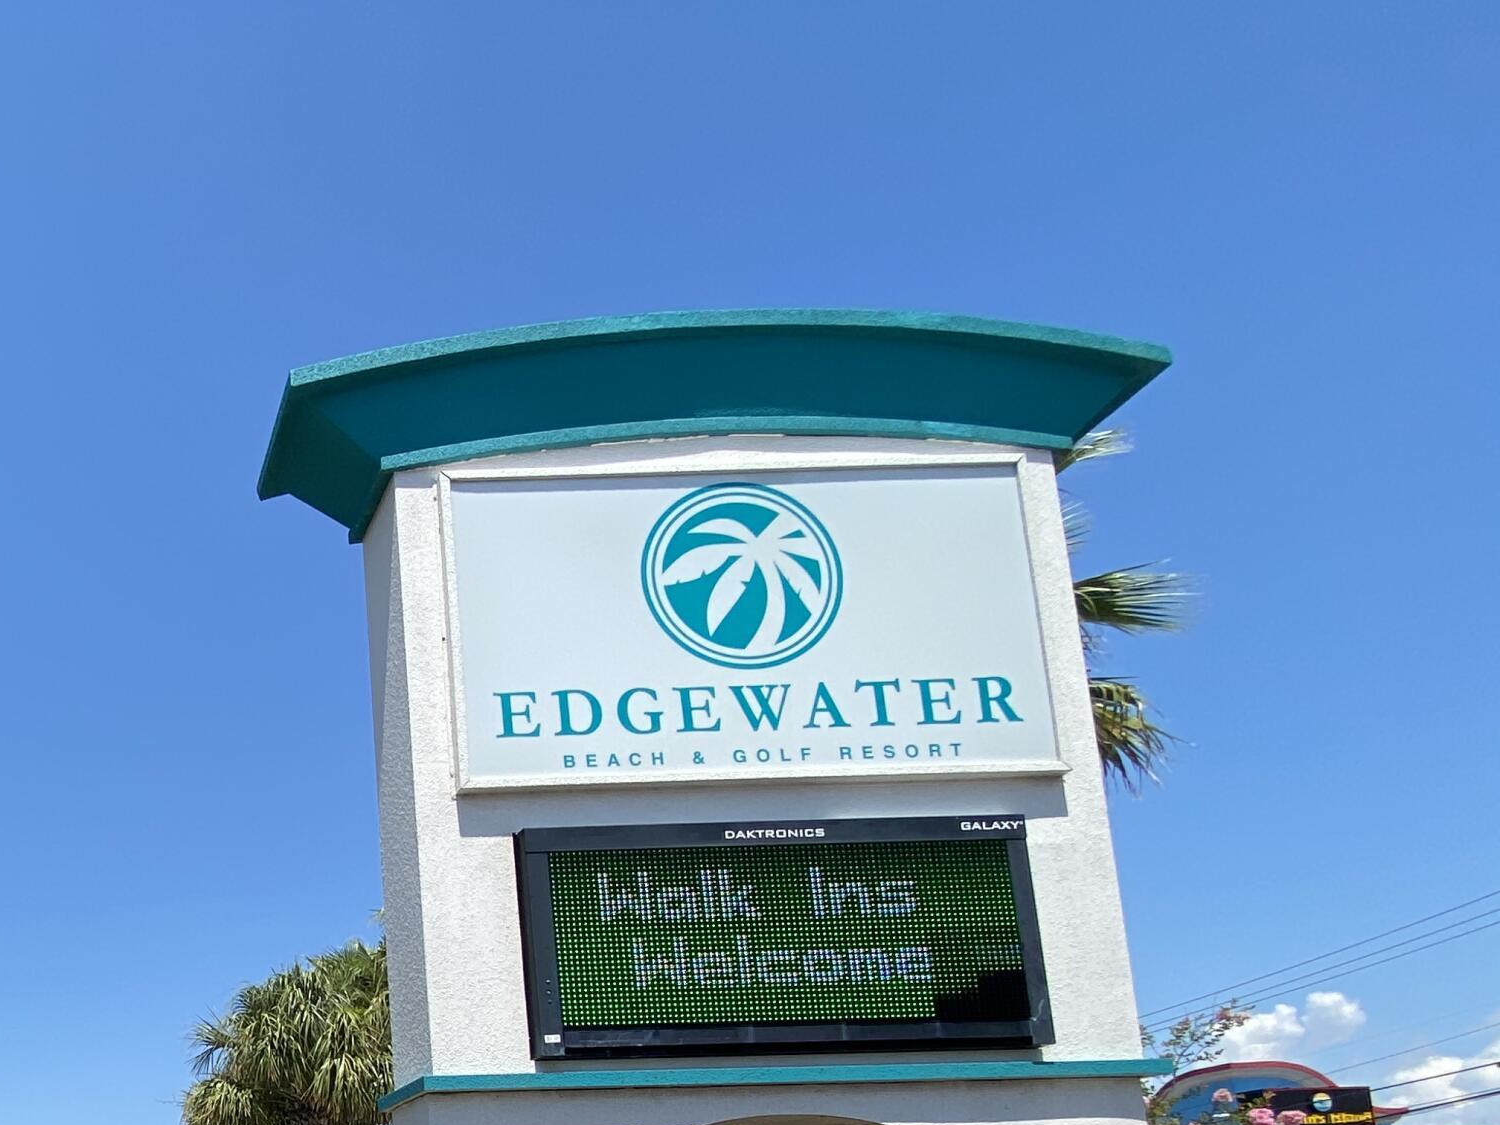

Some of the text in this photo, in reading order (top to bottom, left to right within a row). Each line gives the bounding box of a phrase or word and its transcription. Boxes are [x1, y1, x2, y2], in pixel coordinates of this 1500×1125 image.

[493, 676, 1024, 739] EDGEWATER
[562, 743, 965, 769] BEACH & GOLF RESORT
[723, 828, 826, 840] DAKTRONICS
[597, 866, 919, 922] Walk Ins
[632, 935, 936, 988] Welcome
